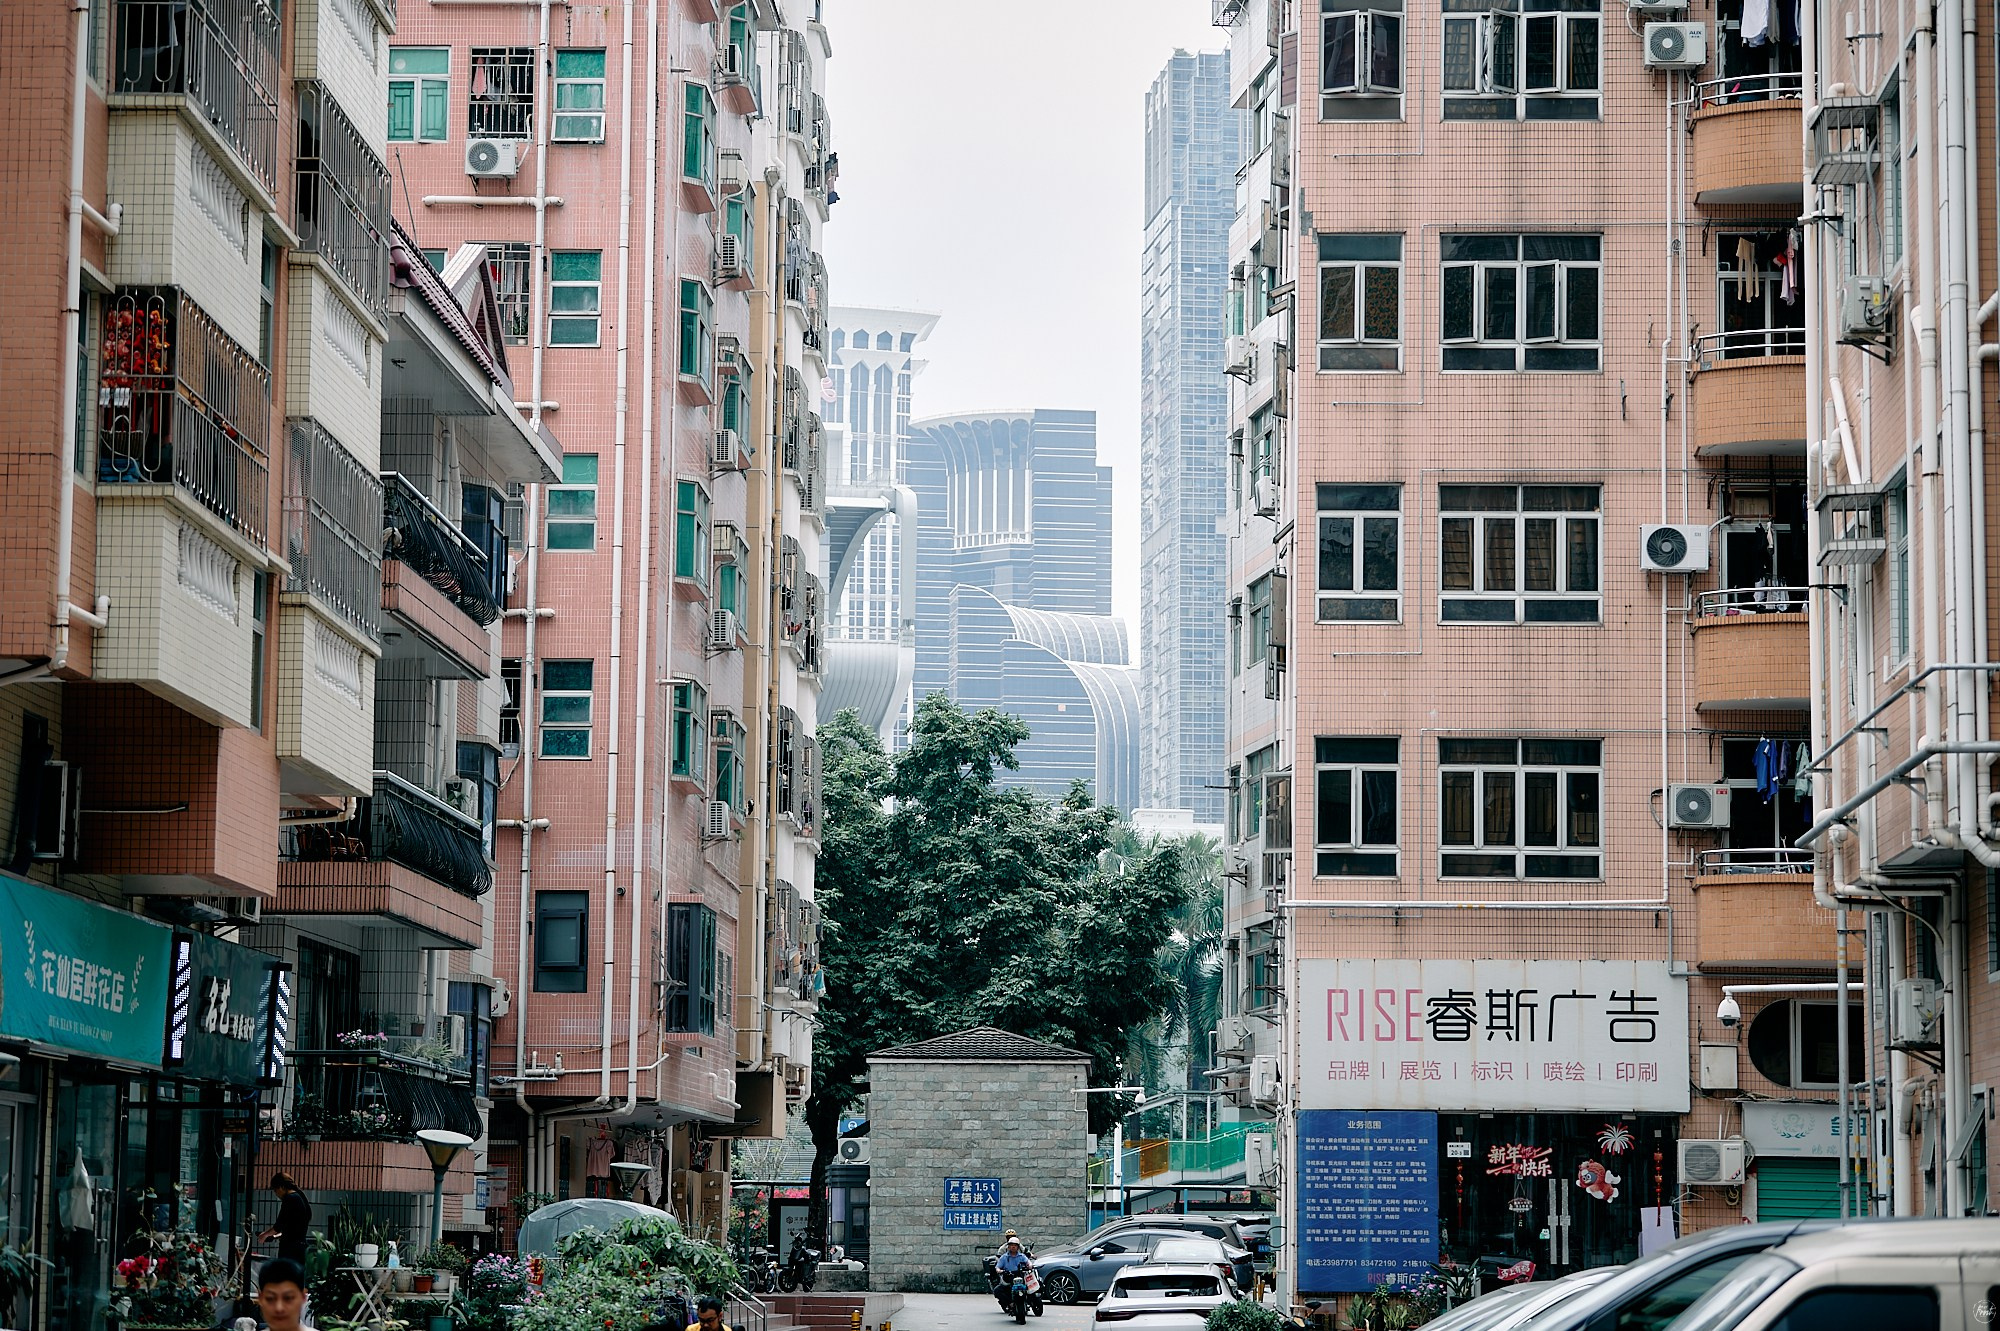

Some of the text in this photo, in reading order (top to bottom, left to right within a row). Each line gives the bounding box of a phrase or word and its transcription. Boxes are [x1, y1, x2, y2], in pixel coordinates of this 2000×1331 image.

[42, 949, 125, 1014] 花仙居鲜花店
[1326, 988, 1660, 1042] RISE 睿斯广告
[80, 1022, 100, 1039] FLOWER
[1328, 1060, 1658, 1082] 品牌 展览 标识 喷绘 印刷
[1347, 1120, 1381, 1129] 业务范围
[1487, 1145, 1522, 1164] 新年
[1520, 1157, 1553, 1177] 快乐
[949, 1193, 995, 1204] 车辆进入
[947, 1213, 999, 1225] 人行道上禁止停车
[1368, 1273, 1385, 1283] RISE
